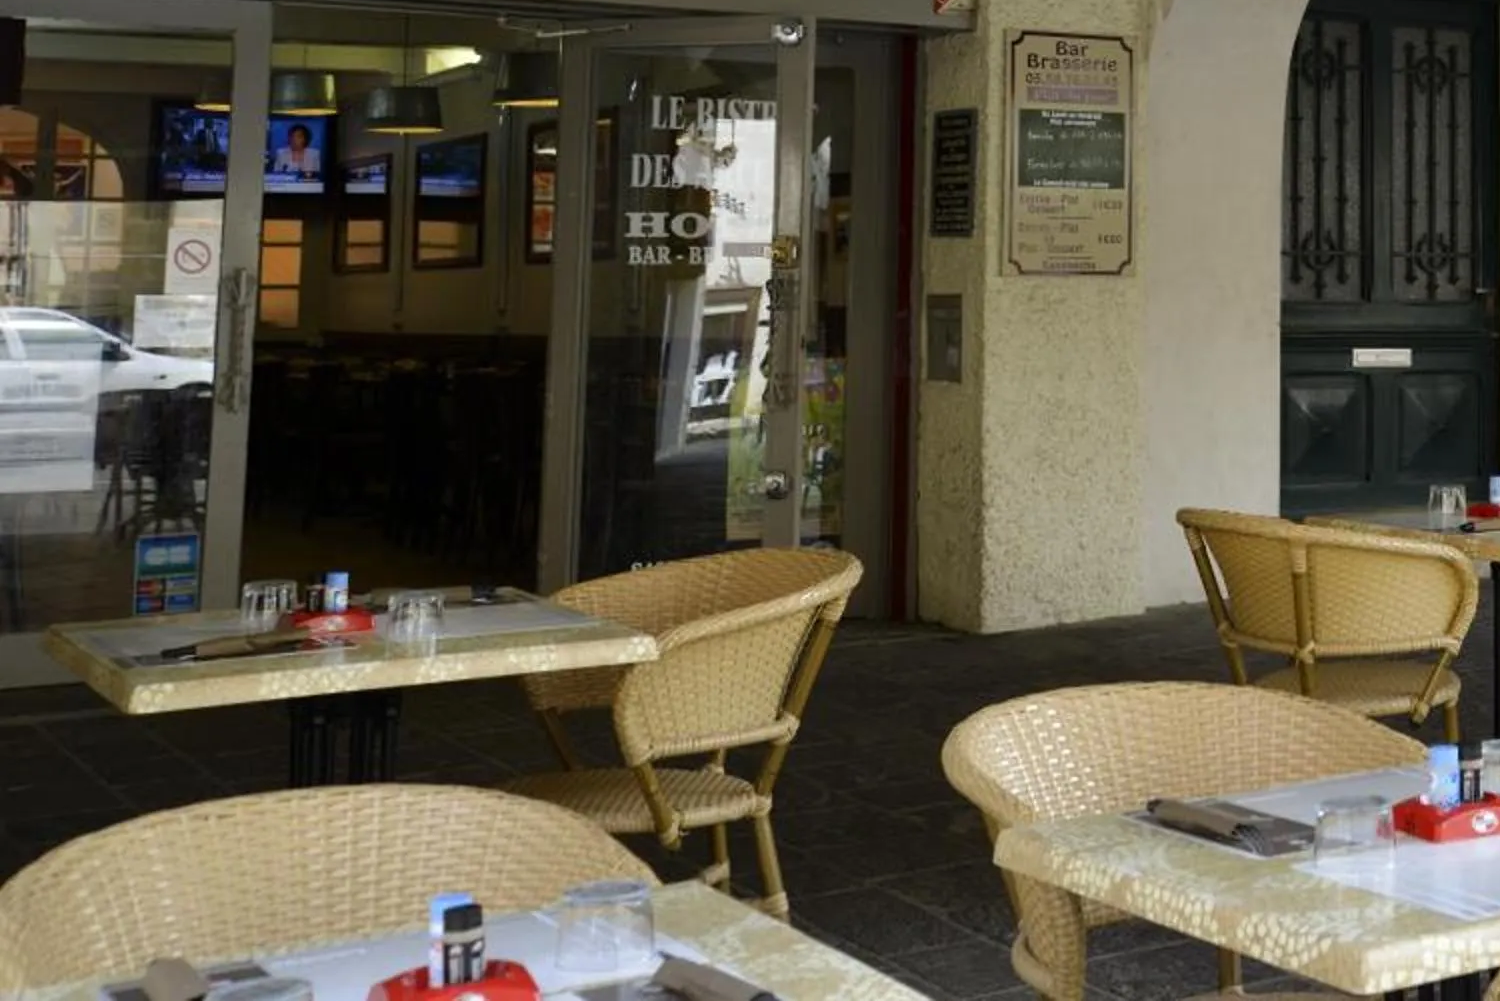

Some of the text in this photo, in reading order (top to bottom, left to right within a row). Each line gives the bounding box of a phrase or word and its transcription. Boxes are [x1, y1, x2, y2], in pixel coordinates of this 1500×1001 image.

[1056, 40, 1088, 57] Bar
[1027, 53, 1117, 72] Brasserie
[651, 96, 685, 129] LE
[628, 246, 671, 265] BAR
